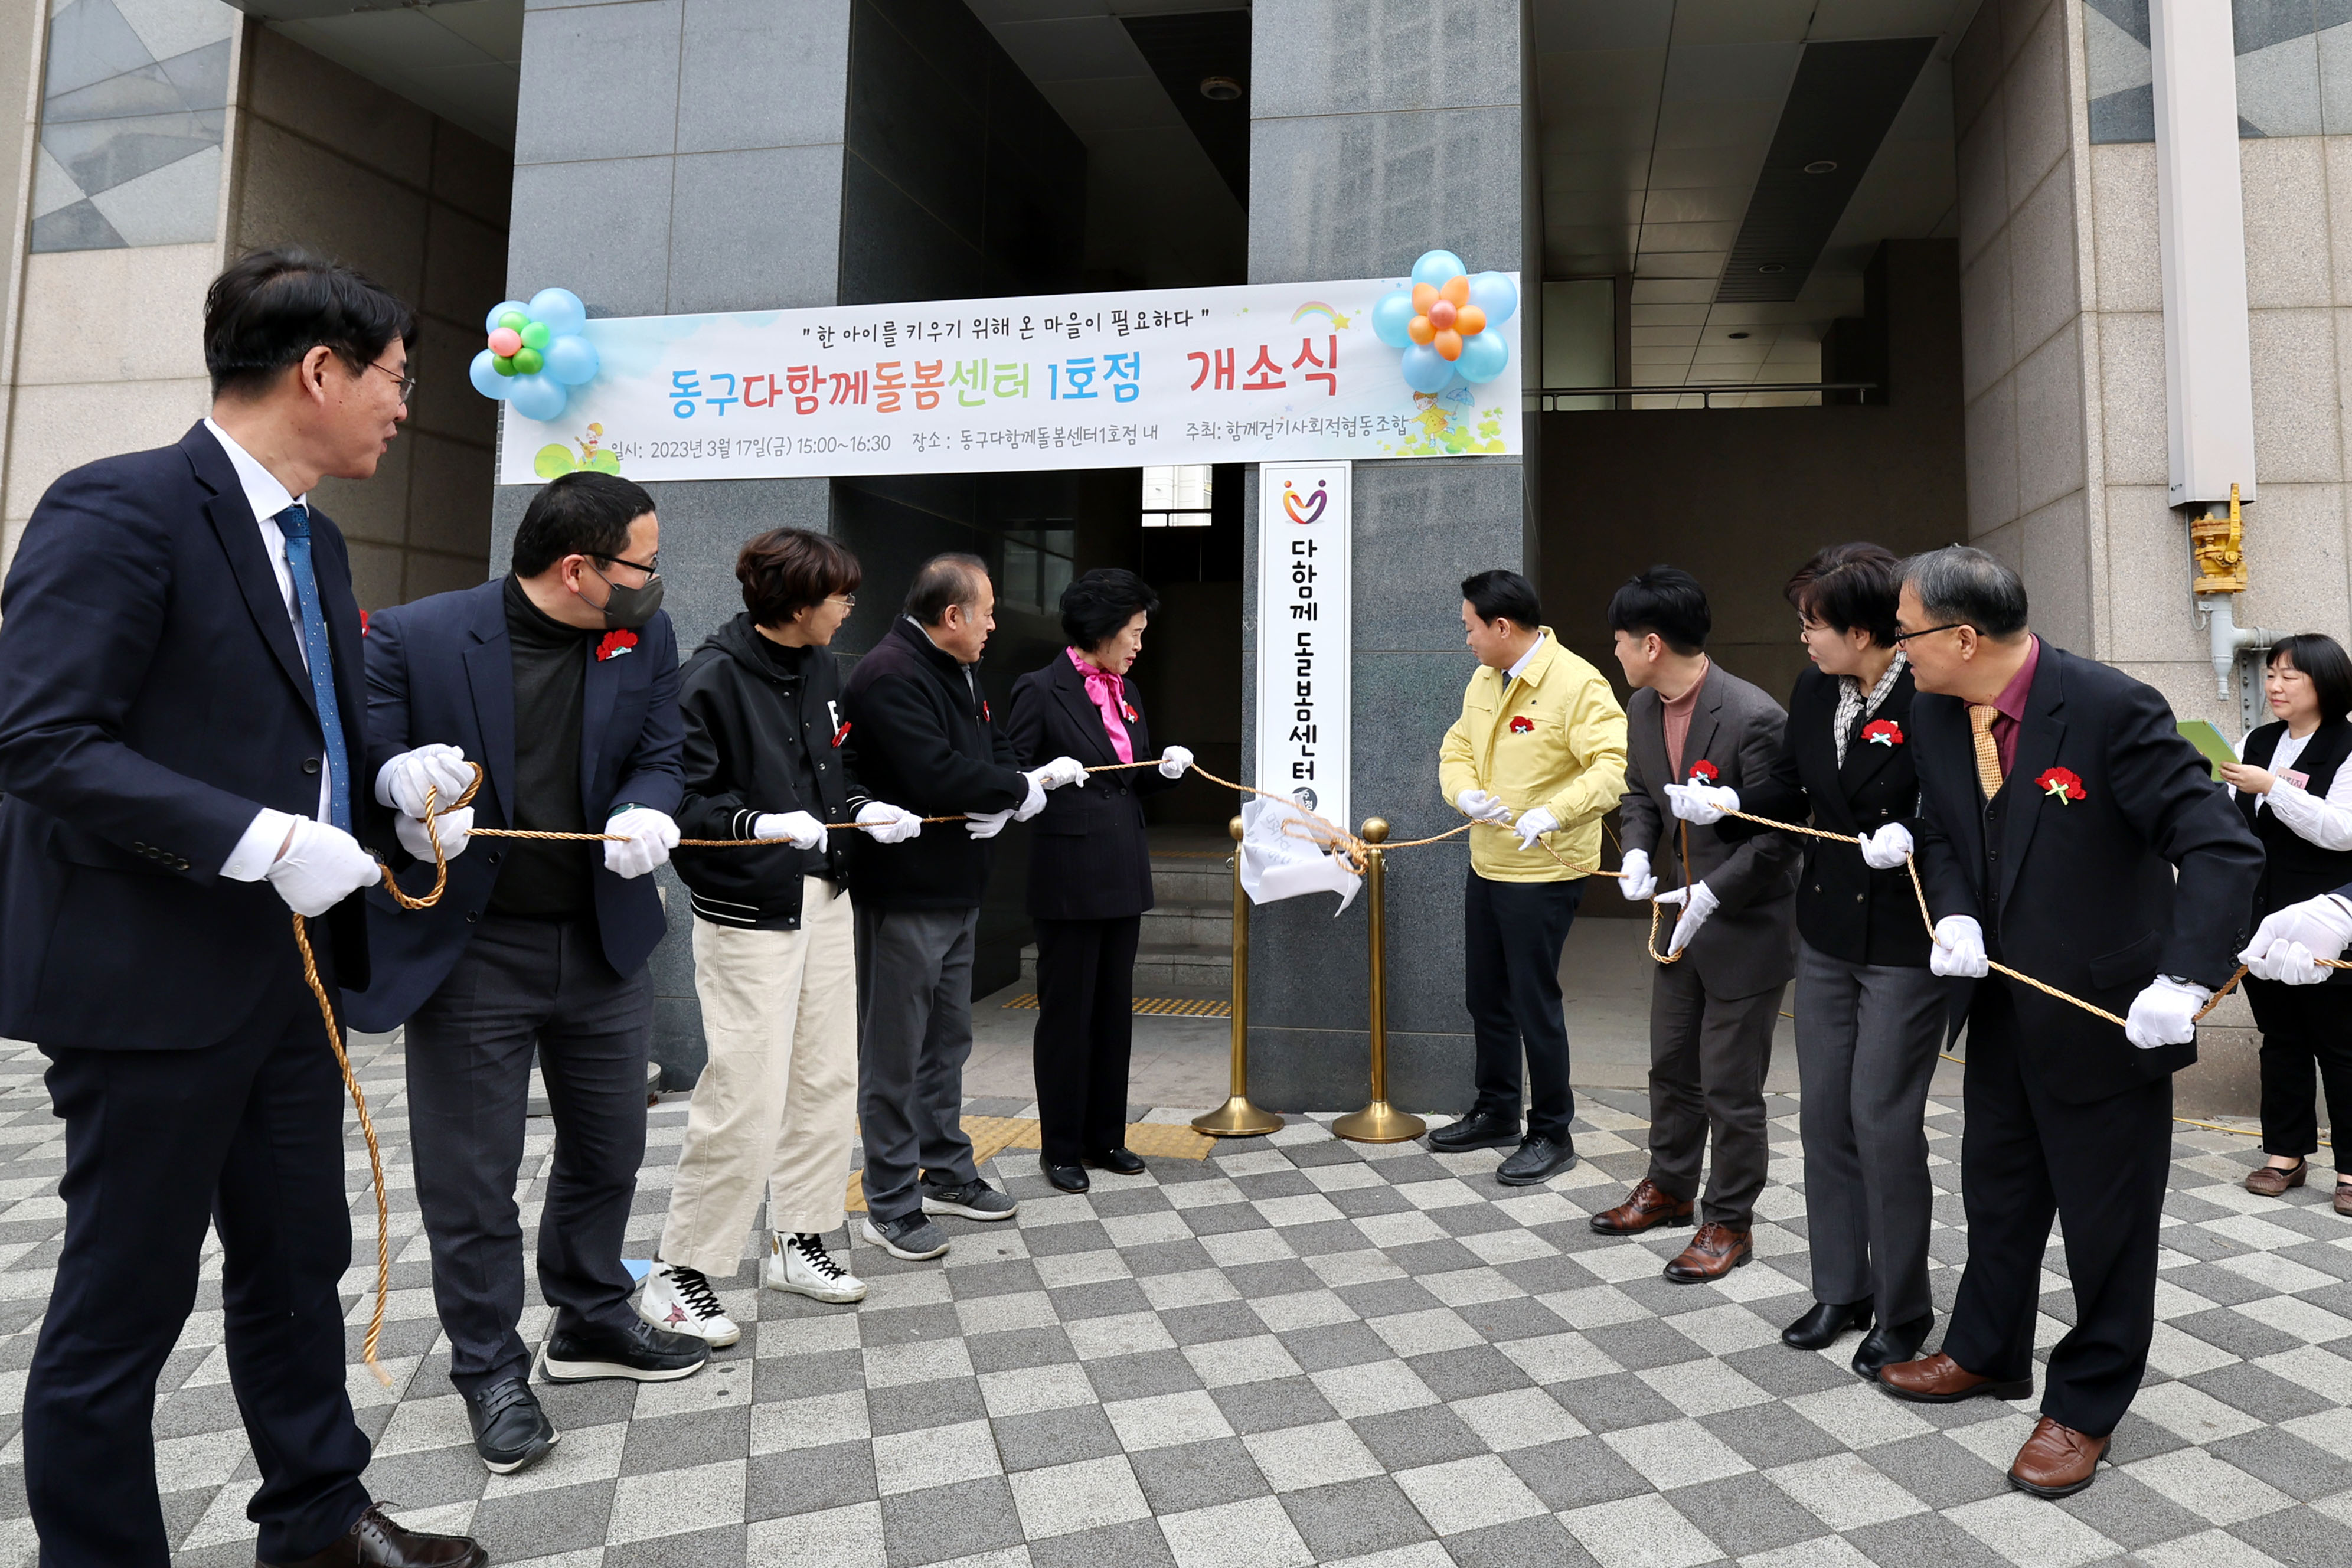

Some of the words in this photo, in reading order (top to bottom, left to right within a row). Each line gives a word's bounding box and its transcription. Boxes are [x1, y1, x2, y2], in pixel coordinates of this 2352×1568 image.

[843, 321, 897, 348] 아이를
[906, 319, 961, 342] 키우기
[972, 317, 1009, 340] 위해
[1018, 315, 1034, 340] 온
[1044, 312, 1100, 339] 마을이
[669, 358, 1029, 419] 동구다함께돌봄센터
[1047, 351, 1141, 403] 1호점
[1187, 334, 1338, 396] 개소식
[960, 424, 1137, 450] 동구다함께돌봄센터1호점
[1143, 424, 1158, 440] 내
[1185, 422, 1221, 442] 주최:
[1226, 414, 1409, 442] 함께걷기사회적협동조합
[611, 440, 642, 462] 일시:
[651, 439, 703, 459] 2023년
[707, 437, 730, 459] 3월
[736, 436, 792, 458] 17일(금)
[796, 435, 891, 453] 15:00~16:30
[1289, 538, 1318, 622] 다함께
[1289, 632, 1318, 781] 돌봄센터
